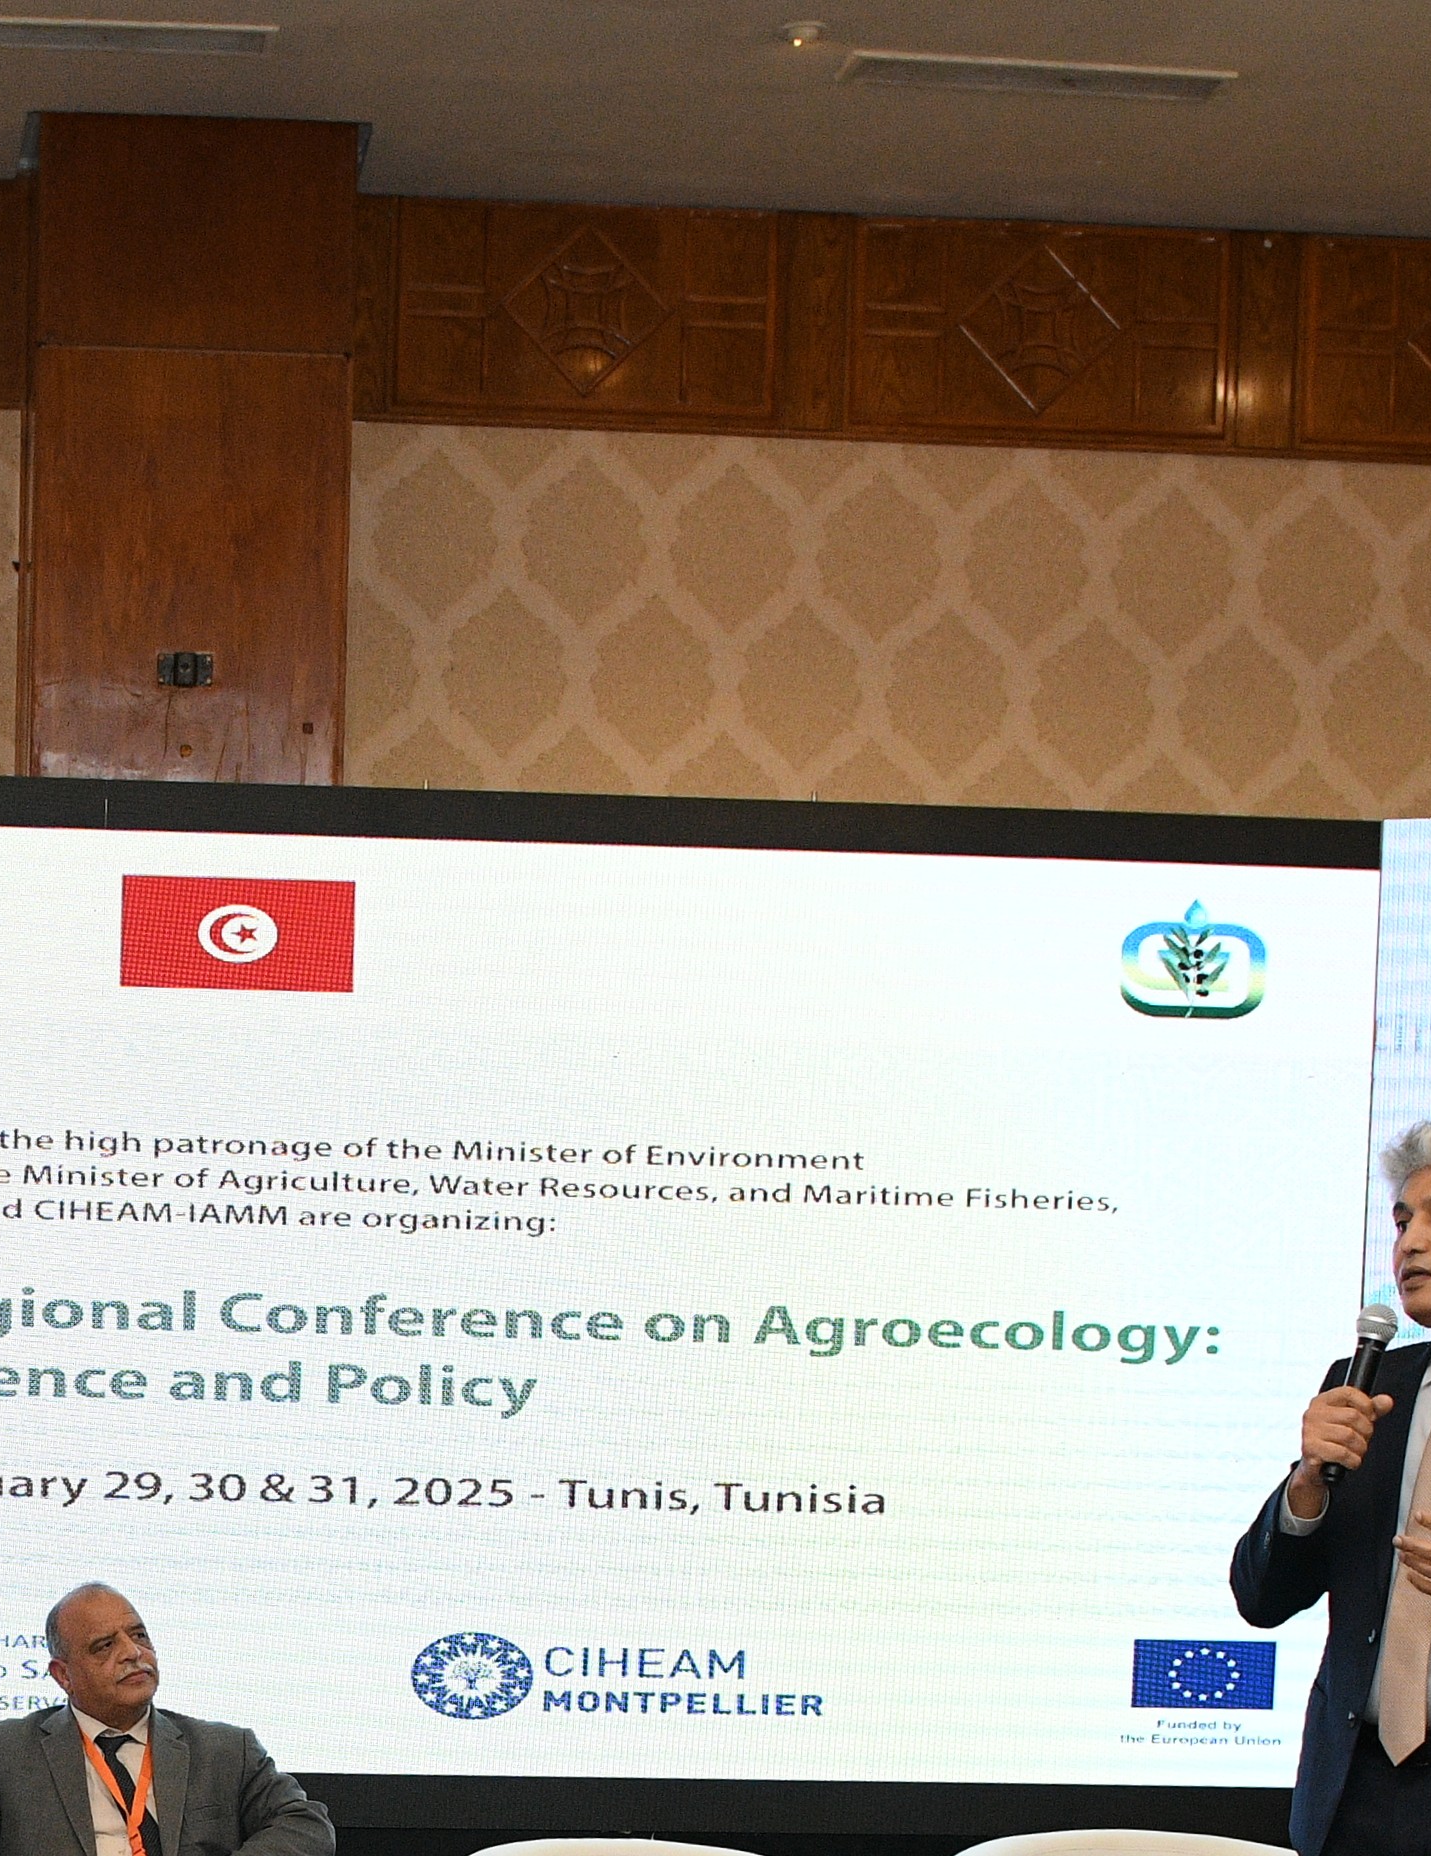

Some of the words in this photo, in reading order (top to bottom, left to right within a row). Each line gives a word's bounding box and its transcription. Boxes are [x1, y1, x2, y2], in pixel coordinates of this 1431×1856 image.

[65, 1130, 141, 1158] high
[154, 1134, 332, 1162] patronage
[343, 1135, 378, 1158] of
[388, 1137, 442, 1161] the
[454, 1139, 593, 1165] Minister
[603, 1143, 638, 1166] of
[647, 1145, 864, 1171] Environment
[23, 1164, 163, 1190] Minister
[174, 1167, 209, 1189] of
[218, 1169, 419, 1197] Agriculture,
[430, 1174, 529, 1198] Water
[540, 1177, 718, 1203] Resources,
[728, 1181, 791, 1204] and
[803, 1184, 954, 1208] Maritime
[965, 1188, 1119, 1214] Fisheries,
[35, 1199, 288, 1227] CIHEAM-IAMM
[299, 1208, 352, 1228] are
[362, 1206, 556, 1237] organizing:
[219, 1291, 624, 1342] Conference
[645, 1311, 731, 1344] on
[753, 1305, 1221, 1366] Agroecology:
[169, 1361, 301, 1404] and
[327, 1363, 538, 1419] Policy
[104, 1470, 173, 1506] 29,
[190, 1472, 246, 1502] 30
[260, 1472, 295, 1503] &
[308, 1474, 376, 1509] 31,
[393, 1477, 514, 1508] 2025
[558, 1479, 699, 1516] Tunis,
[714, 1483, 886, 1515] Tunisia
[544, 1646, 745, 1680] CIHEAM
[542, 1689, 823, 1718] MONTPELLIER
[1120, 1734, 1145, 1744] the
[1151, 1734, 1229, 1746] European
[1234, 1736, 1282, 1747] Union
[1156, 1719, 1217, 1730] Funded
[1223, 1721, 1242, 1732] by
